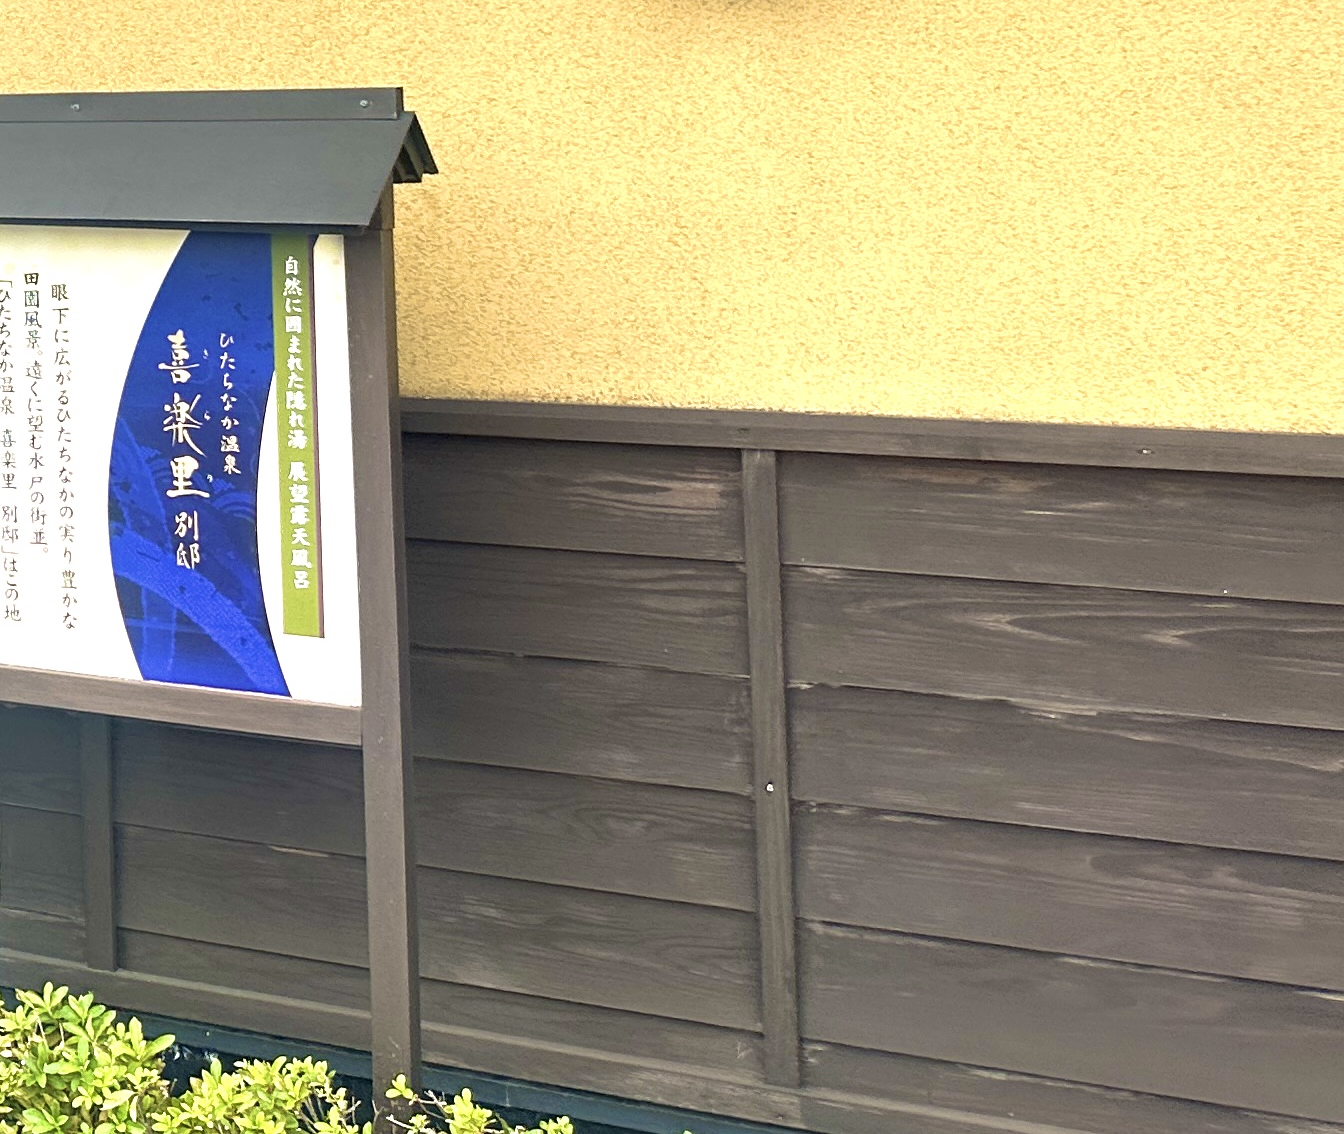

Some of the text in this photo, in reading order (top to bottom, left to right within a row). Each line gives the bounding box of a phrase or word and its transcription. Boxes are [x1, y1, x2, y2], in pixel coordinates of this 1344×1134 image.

[158, 329, 210, 570] 喜楽里 別邸
[288, 462, 312, 589] 展望露天風呂
